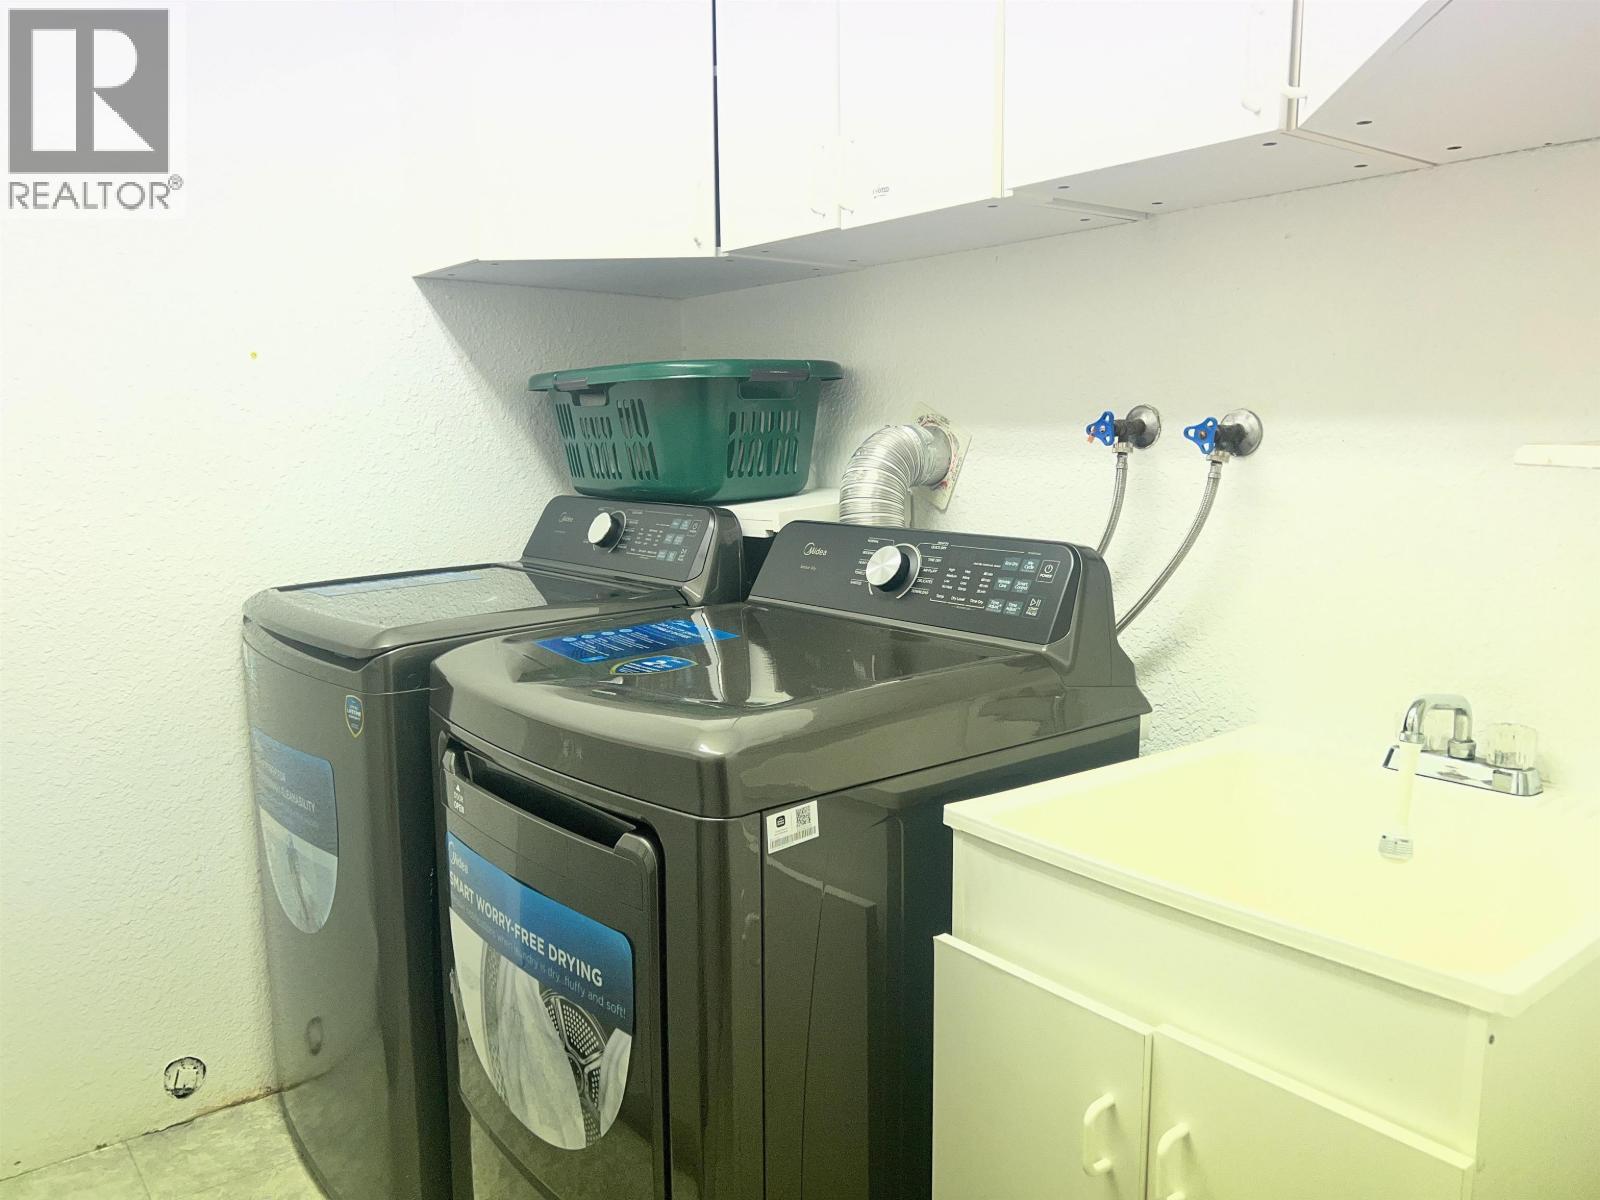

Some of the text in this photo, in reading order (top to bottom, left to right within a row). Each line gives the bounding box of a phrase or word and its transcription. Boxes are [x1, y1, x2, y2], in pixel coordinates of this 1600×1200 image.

[803, 542, 828, 556] Midea
[453, 800, 465, 814] OPEN
[449, 871, 475, 904] SMART
[475, 893, 545, 956] WORRY-FREE
[548, 943, 603, 987] DRYING
[564, 975, 586, 997] fluffy
[587, 992, 604, 1006] and
[606, 1001, 626, 1019] soft!
